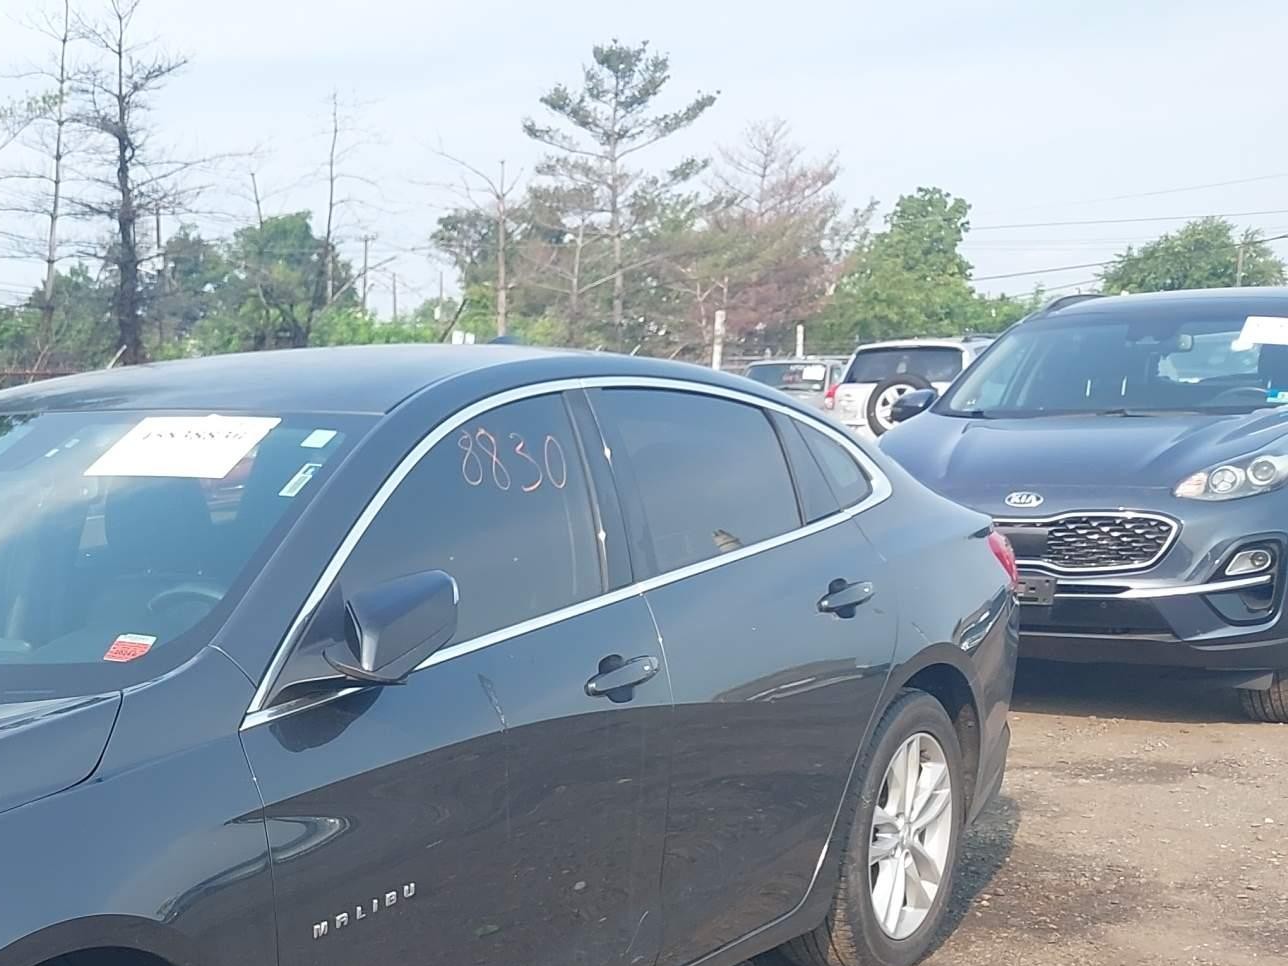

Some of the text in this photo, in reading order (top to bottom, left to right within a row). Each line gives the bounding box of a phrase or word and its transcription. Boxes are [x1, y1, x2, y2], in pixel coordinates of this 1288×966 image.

[458, 428, 567, 492] 8830
[1009, 494, 1040, 506] KIA
[313, 882, 415, 939] MALIBU
